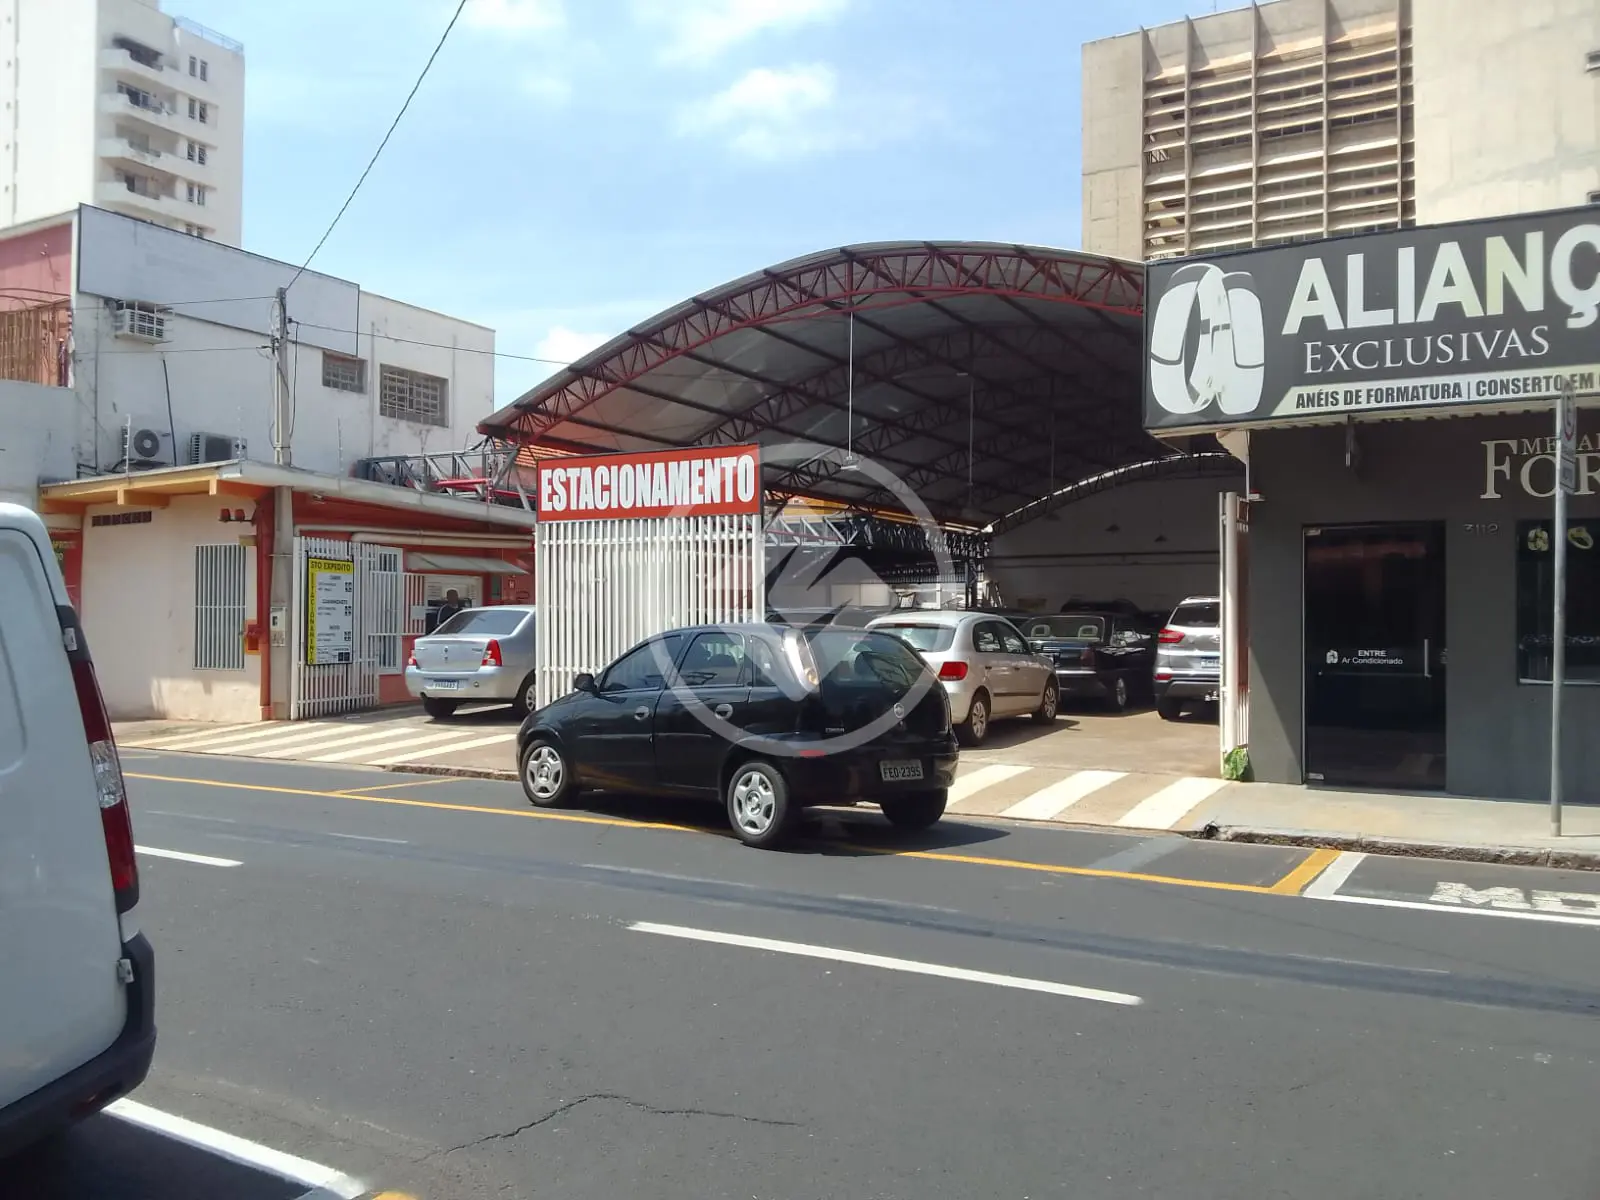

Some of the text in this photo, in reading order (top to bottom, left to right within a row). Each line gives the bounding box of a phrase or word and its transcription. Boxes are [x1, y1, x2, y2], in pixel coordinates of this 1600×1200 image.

[1282, 224, 1600, 335] ALIANÇ
[1303, 325, 1549, 374] EXCLUSIVAS
[1296, 388, 1339, 409] ANÉIS
[1343, 389, 1363, 406] DE
[1366, 381, 1463, 404] FORMATURA
[1475, 374, 1563, 397] CONSERTO
[541, 454, 755, 512] ESTACIONAMENTO
[1352, 657, 1403, 665] Condicionado
